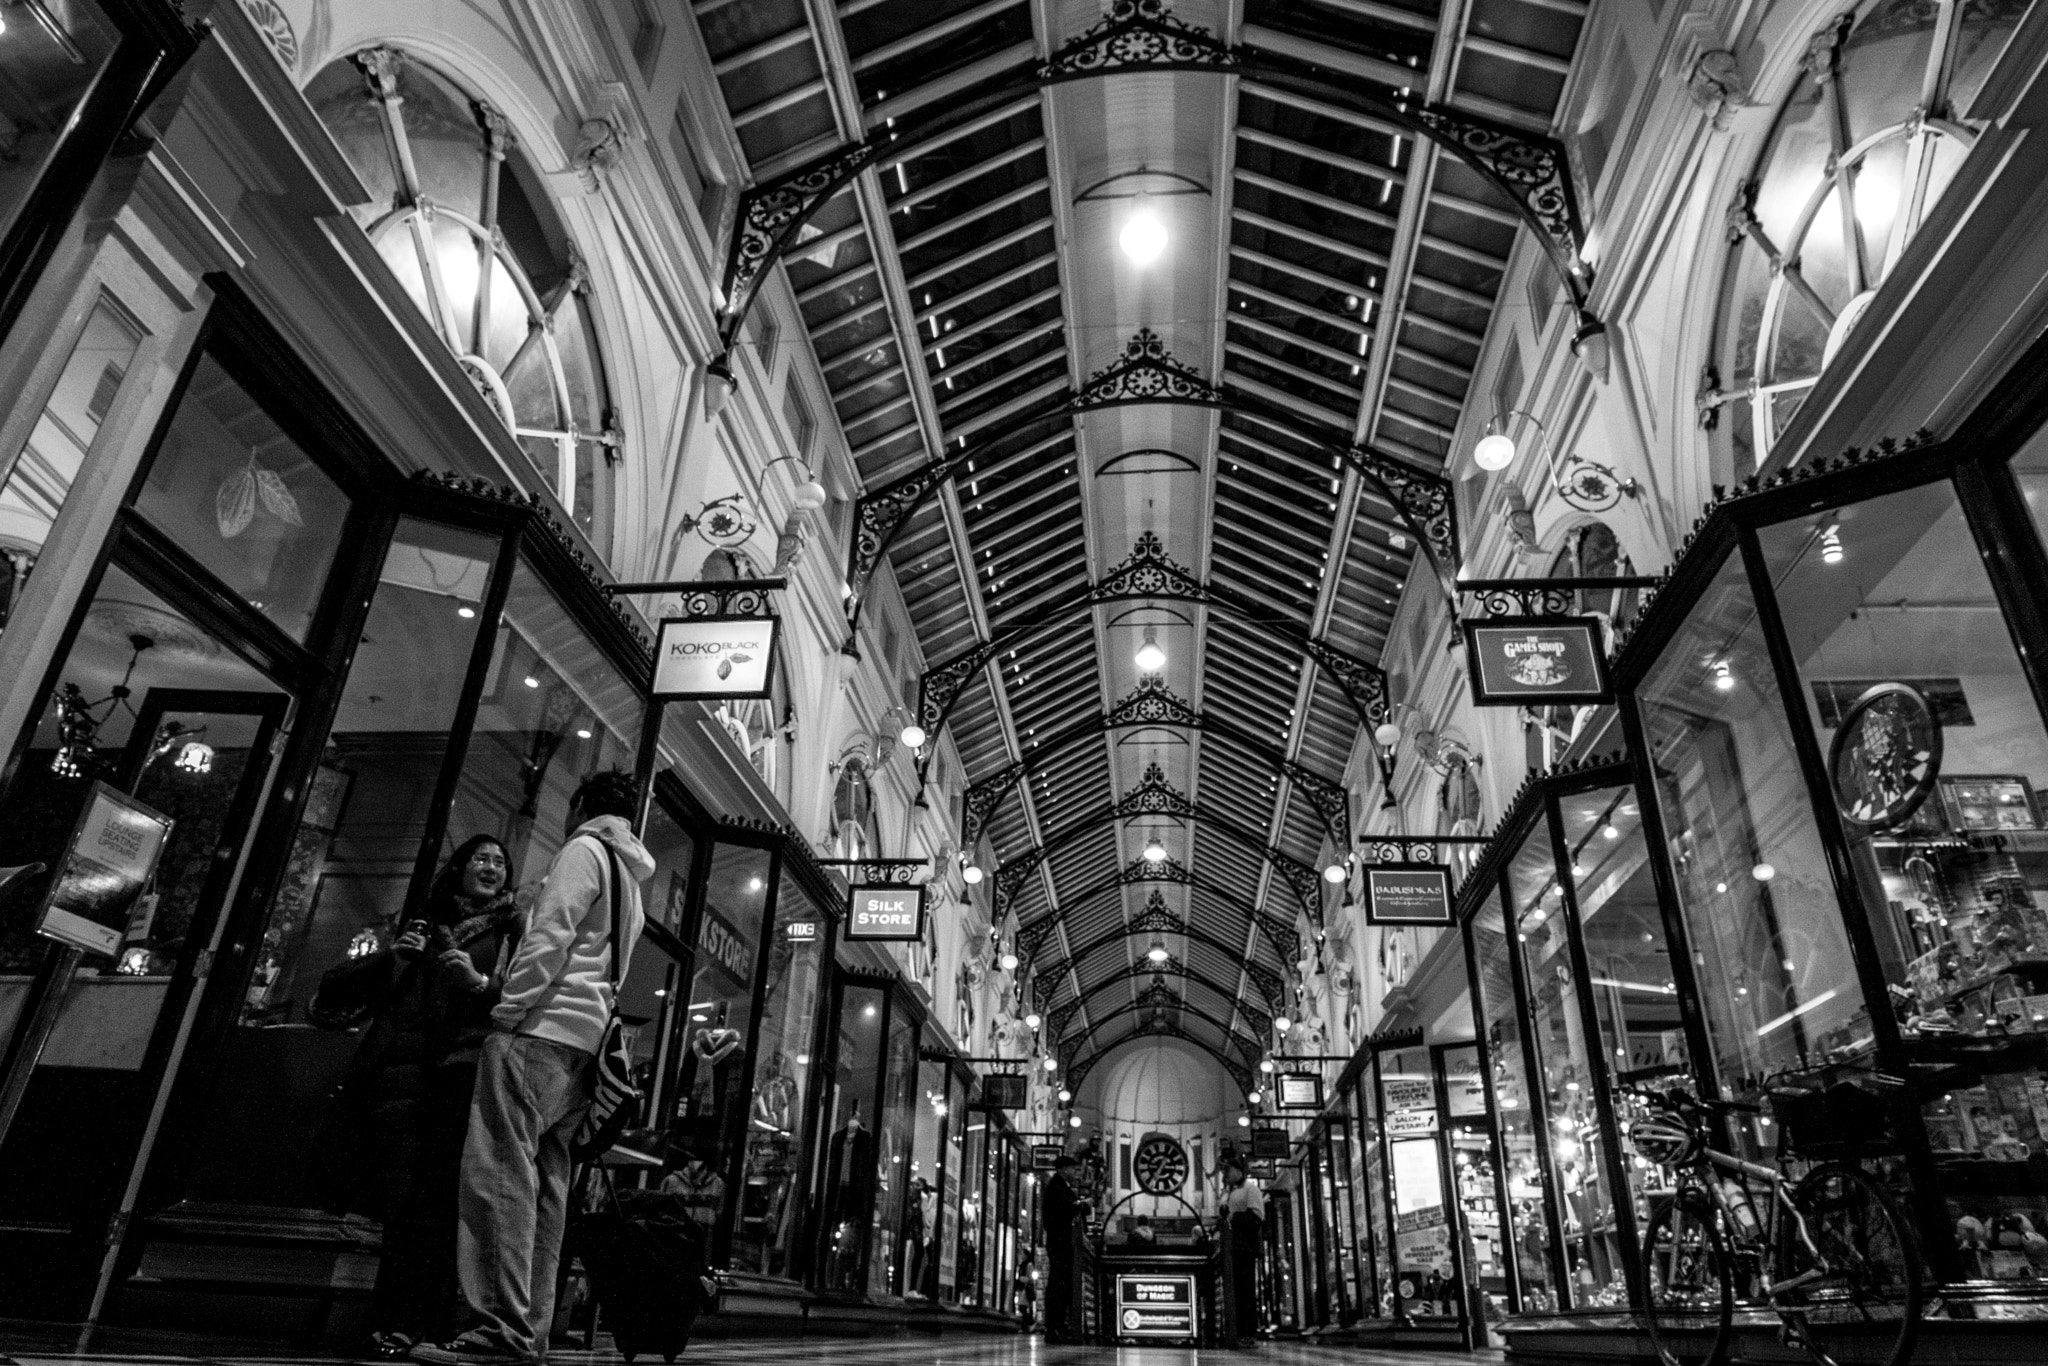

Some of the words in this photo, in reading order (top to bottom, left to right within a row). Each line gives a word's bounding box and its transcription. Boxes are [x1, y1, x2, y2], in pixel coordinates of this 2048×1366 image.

[671, 642, 721, 655] KOKO
[722, 641, 759, 649] BLACK
[1504, 642, 1537, 657] GAMES
[1538, 642, 1565, 657] SHOP
[105, 819, 145, 841] LOUNGE
[101, 828, 141, 852] SEATING
[867, 900, 904, 912] SILK
[857, 912, 912, 925] STORE
[1395, 1115, 1421, 1123] SALON
[1391, 1123, 1426, 1131] UPSTAIRS
